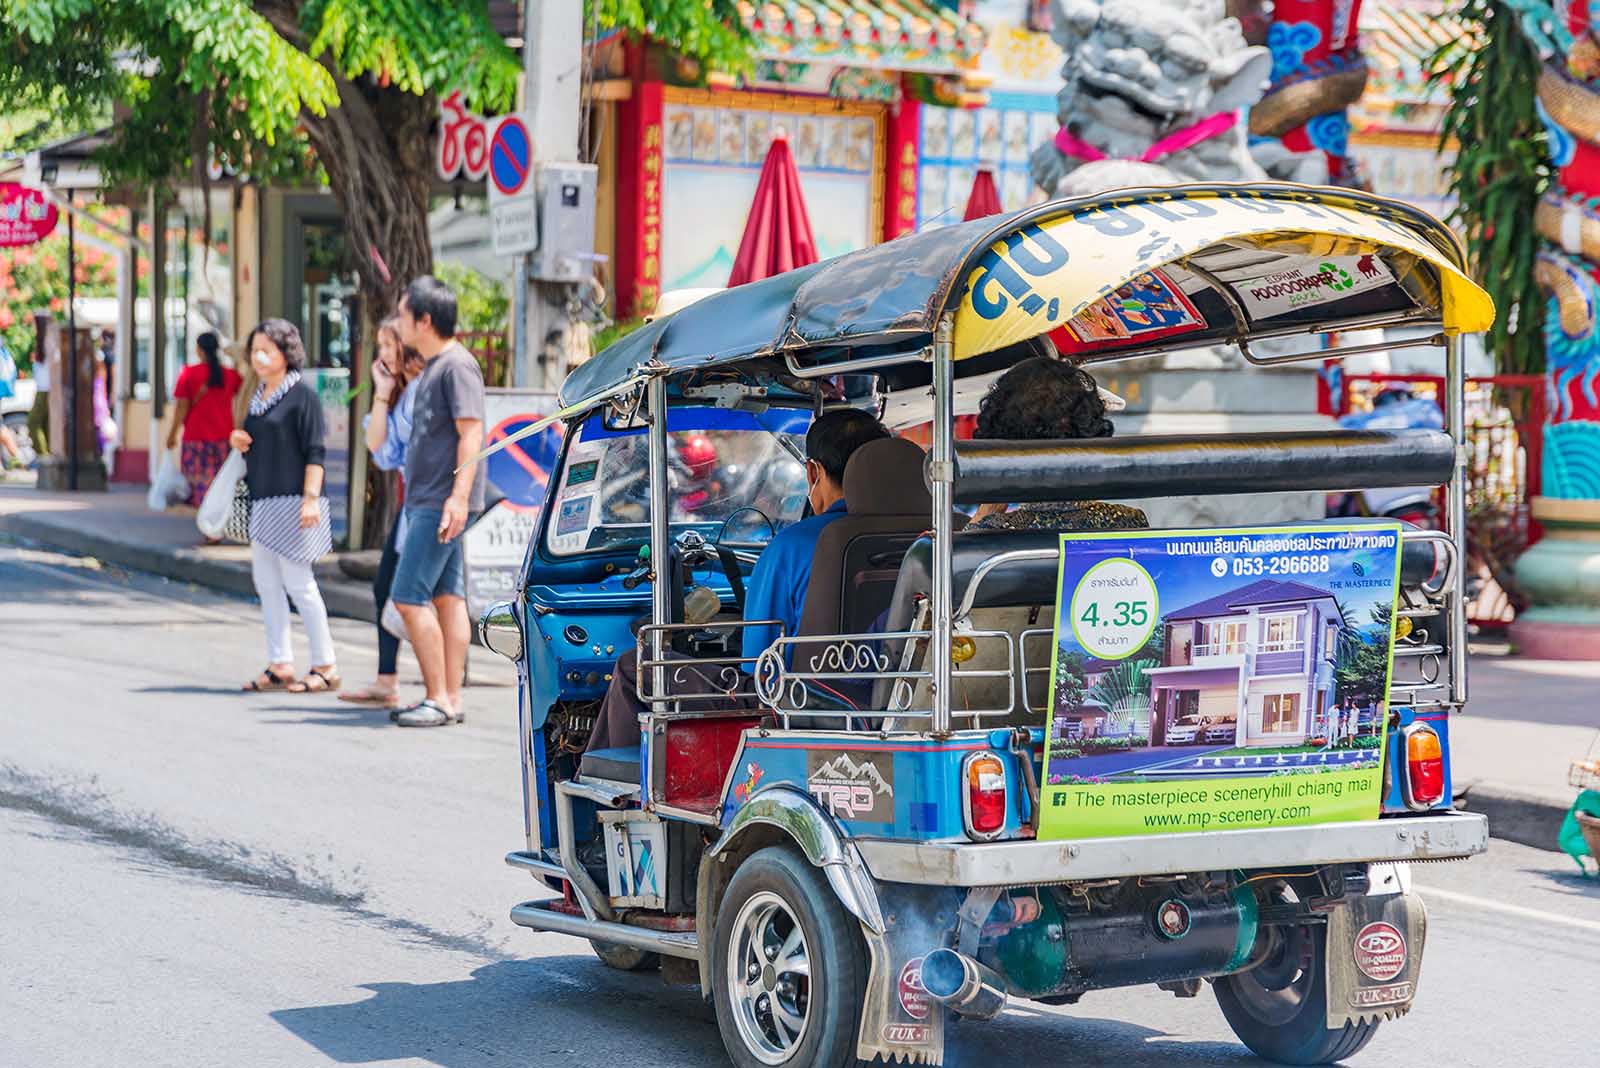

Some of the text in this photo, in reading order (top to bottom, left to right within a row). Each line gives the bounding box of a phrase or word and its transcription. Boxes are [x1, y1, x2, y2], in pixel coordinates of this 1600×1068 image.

[1250, 271, 1338, 301] POOPOOPAPER
[1264, 269, 1303, 284] ELEPHANT
[1232, 555, 1329, 576] 053-296688
[1329, 578, 1392, 589] THE MASTERPIECE
[1080, 601, 1148, 627] 4.35
[809, 785, 874, 818] TRD
[1074, 791, 1105, 807] The
[1112, 789, 1208, 808] masterpiece
[1214, 783, 1292, 803] sceneryhill
[1296, 780, 1343, 798] chiang
[1348, 778, 1372, 793] mai
[1144, 803, 1311, 828] www.mp-scenery.com
